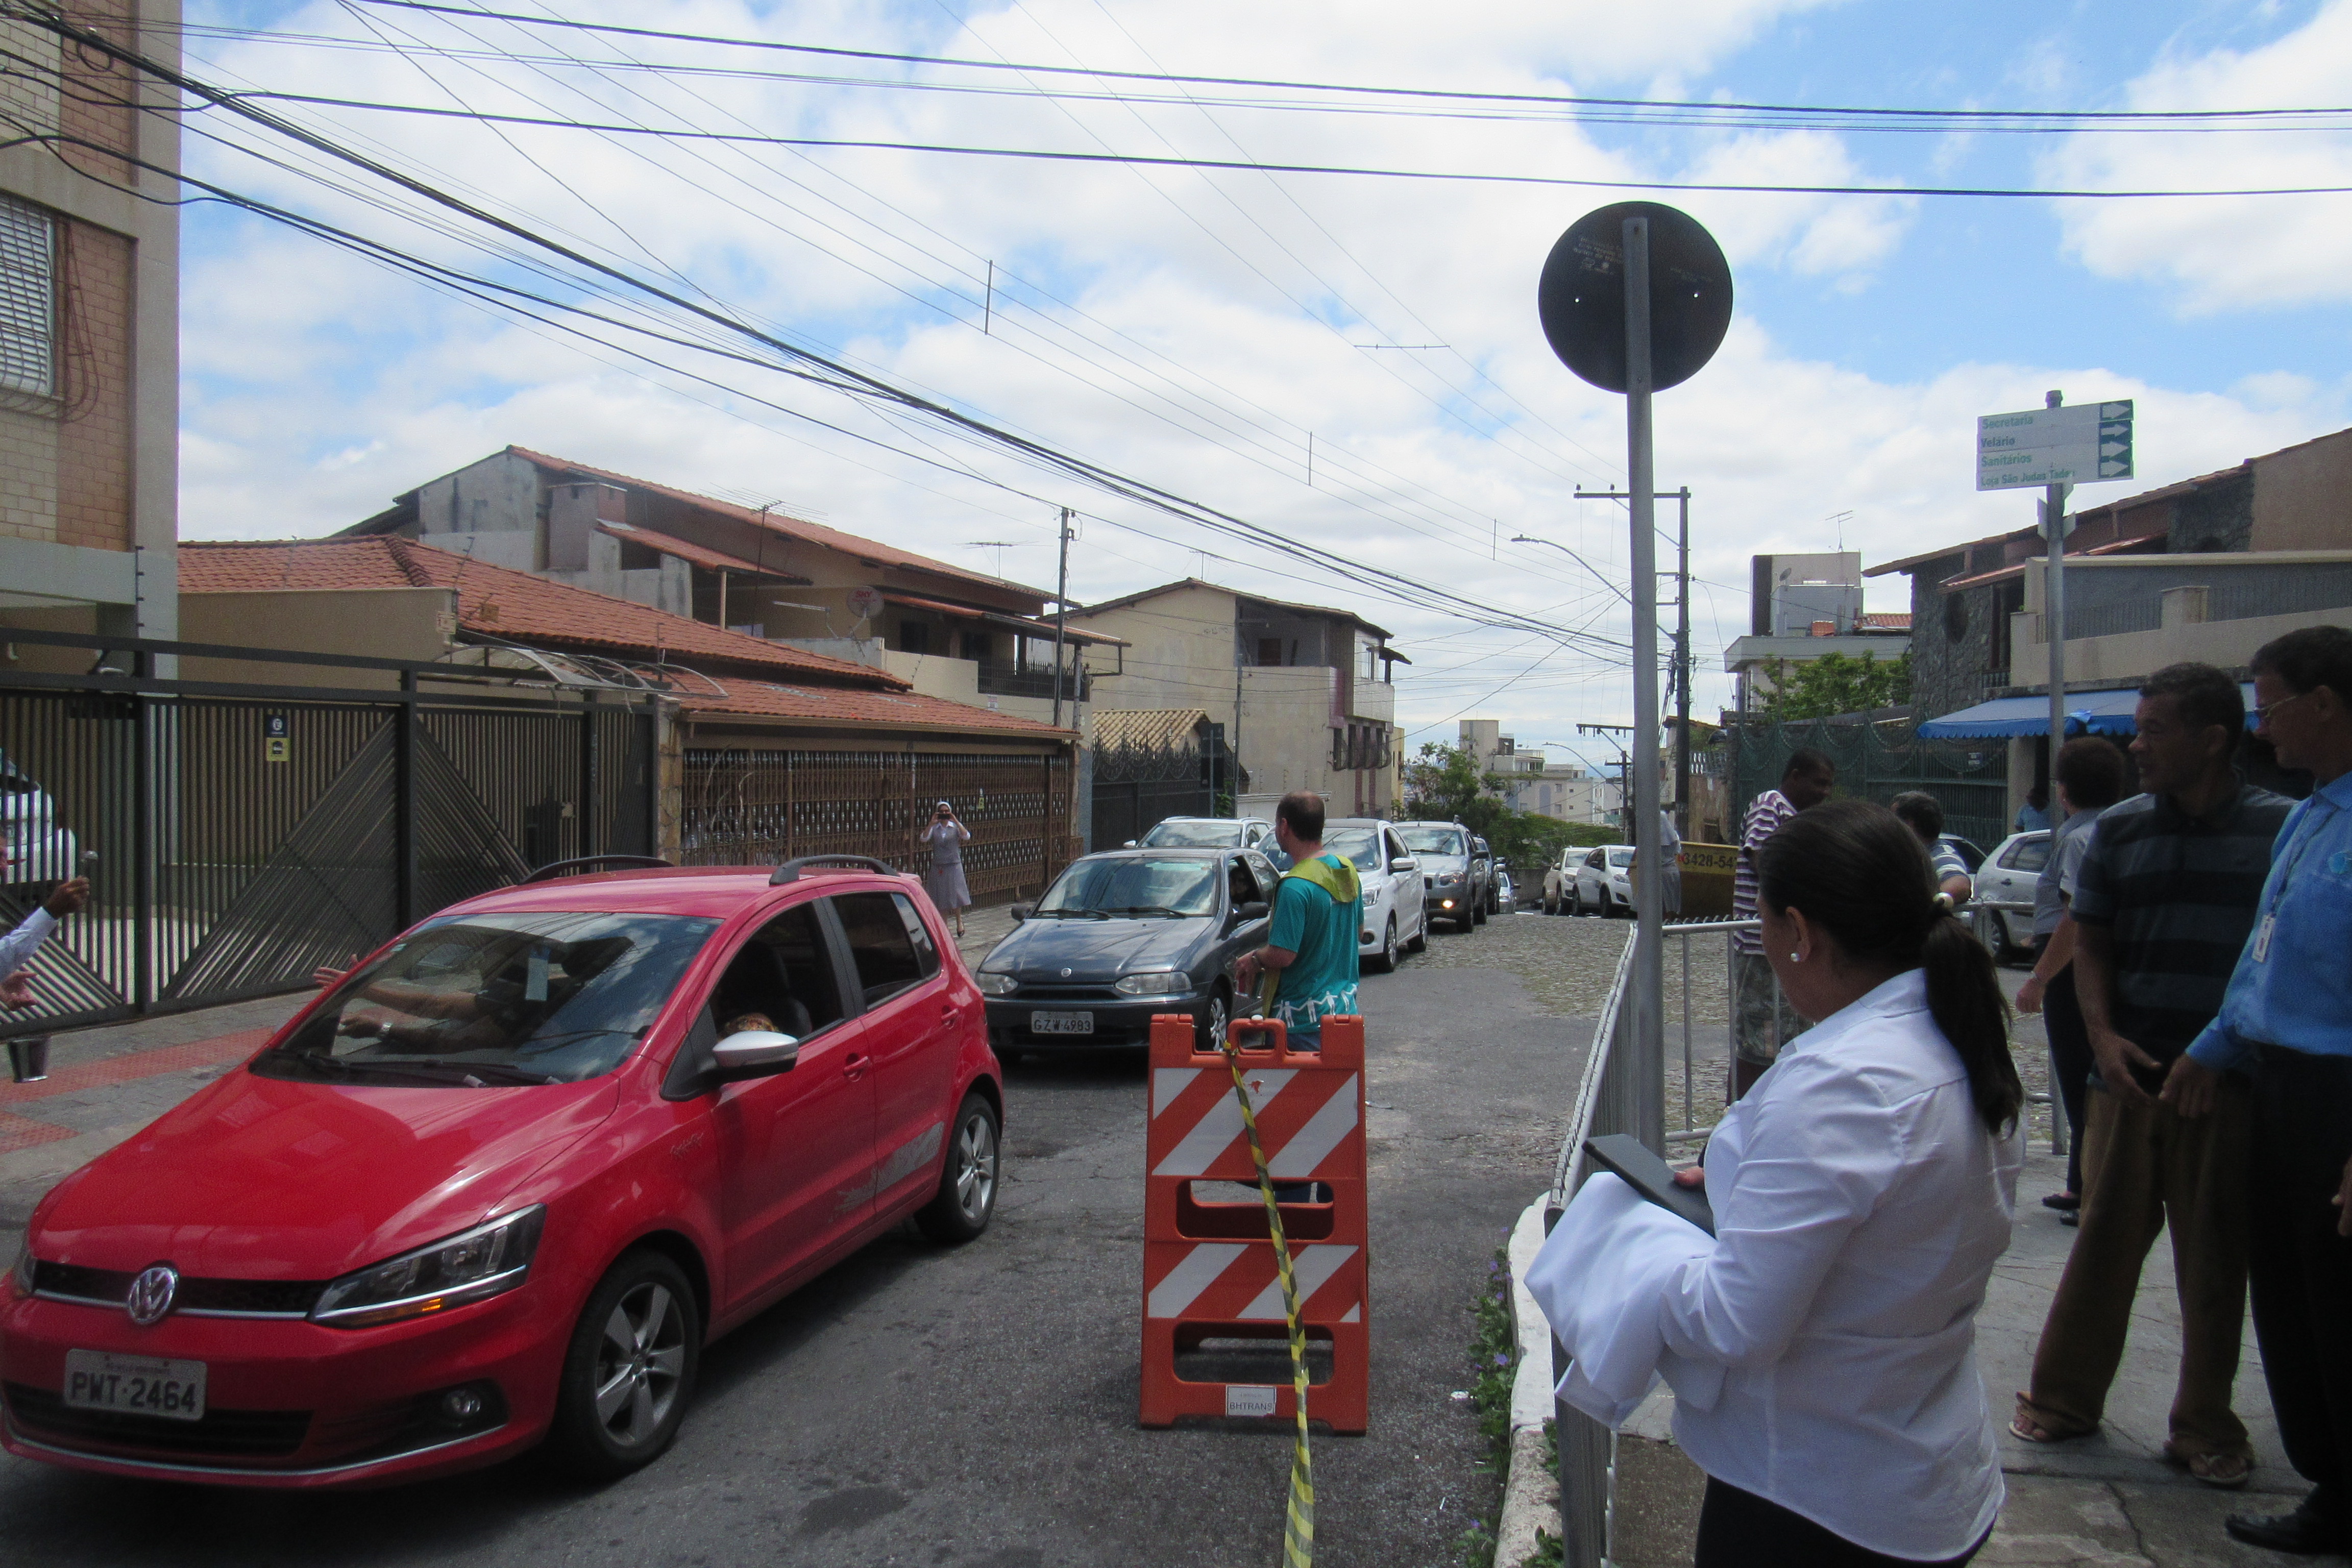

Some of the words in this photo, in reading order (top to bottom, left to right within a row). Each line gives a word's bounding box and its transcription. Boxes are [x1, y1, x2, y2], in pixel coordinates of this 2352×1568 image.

[1982, 414, 2033, 429] Secretaria
[1980, 436, 2016, 448] Velário
[1981, 453, 2032, 467] Sanitários
[2002, 473, 2018, 483] São
[2021, 472, 2046, 482] Judas
[1683, 852, 1737, 868] 3420-54
[1229, 1402, 1273, 1410] BHTRANS
